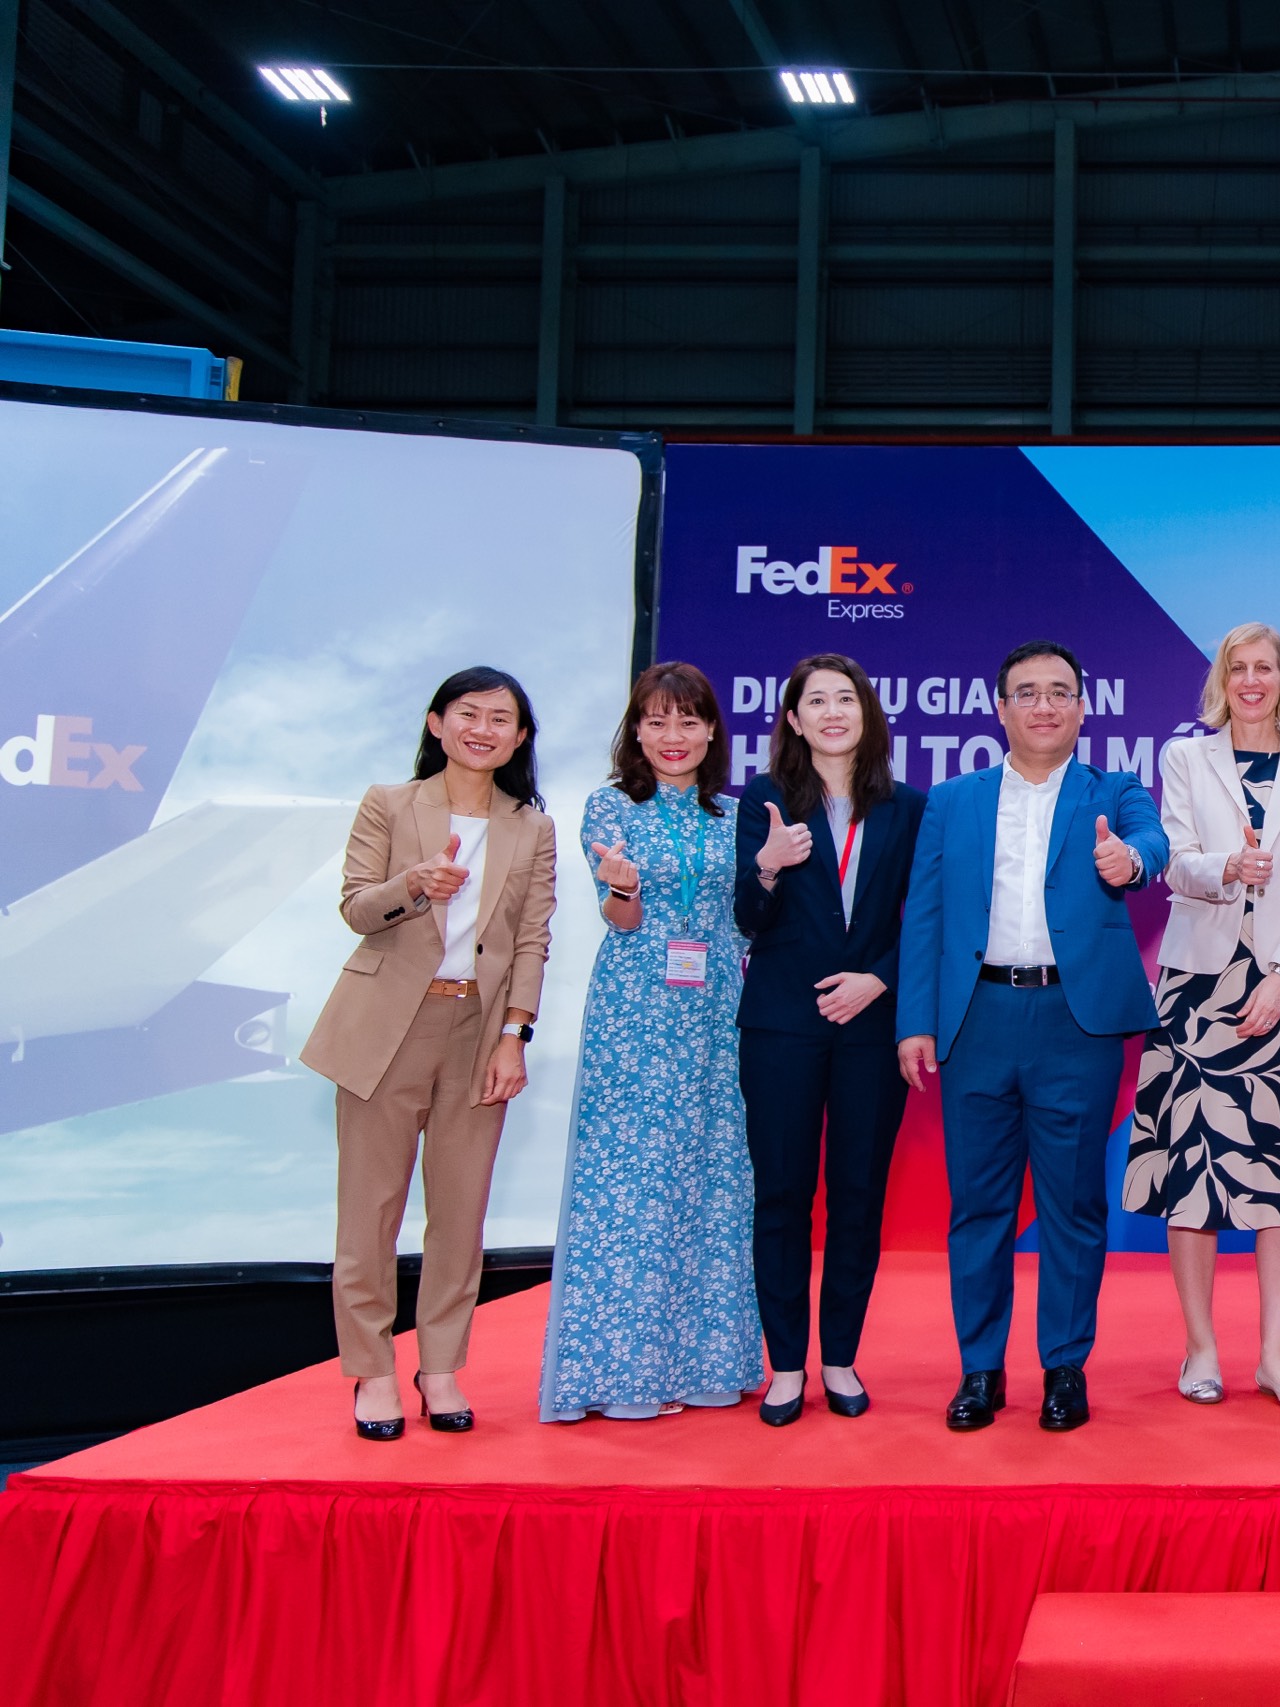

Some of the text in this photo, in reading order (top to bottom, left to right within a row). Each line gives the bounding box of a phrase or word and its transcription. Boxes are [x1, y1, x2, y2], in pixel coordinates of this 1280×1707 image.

[736, 546, 898, 595] FedEx
[827, 599, 905, 623] Express
[732, 676, 791, 724] DỊ
[916, 676, 999, 716] GIA
[0, 713, 148, 792] dEx
